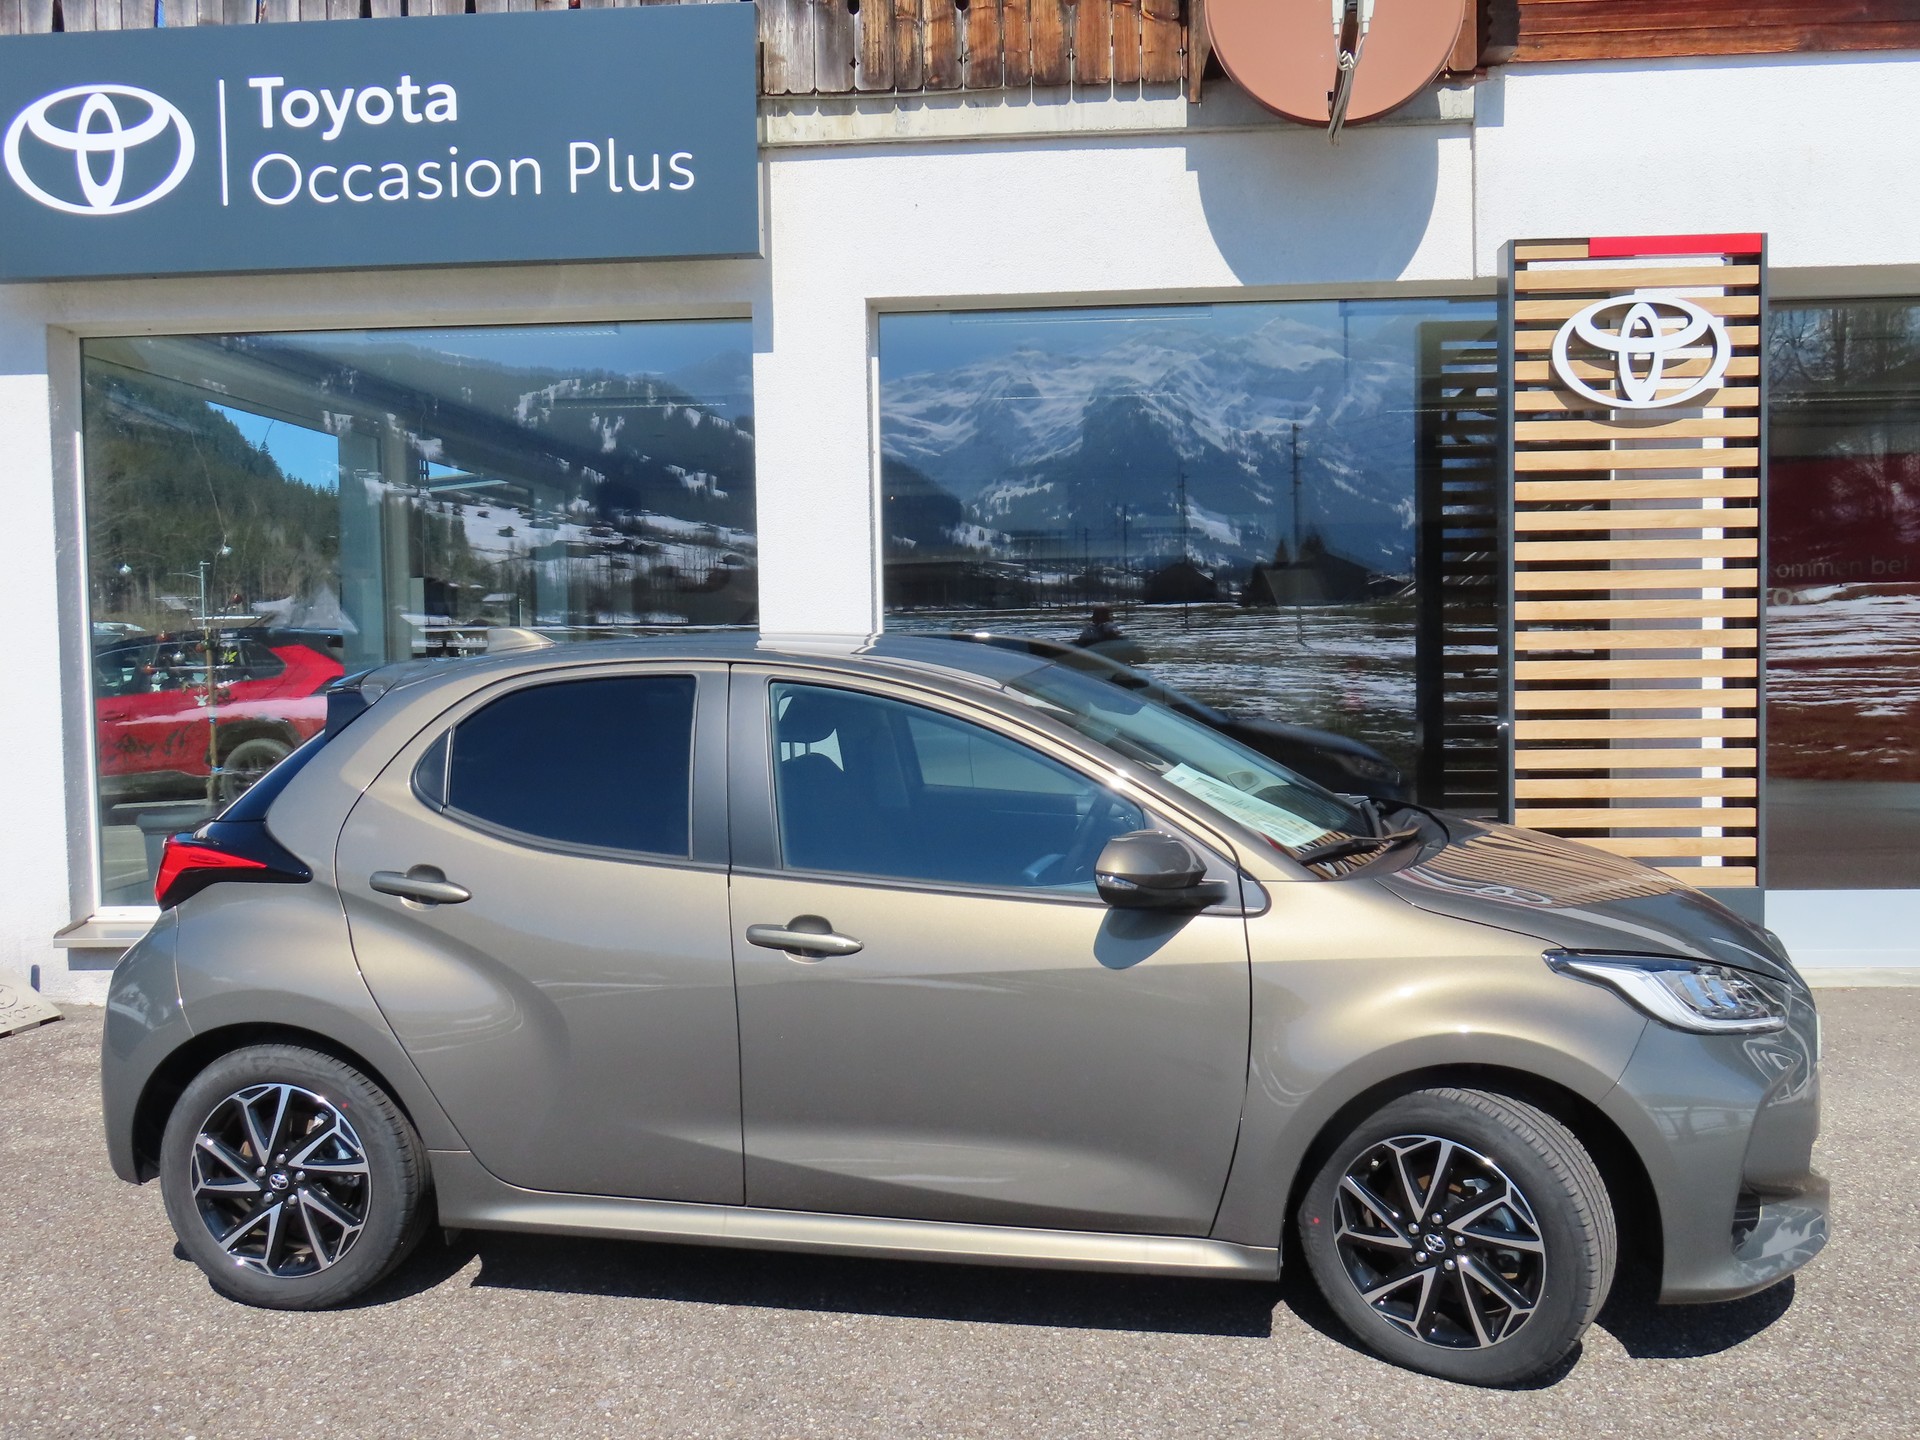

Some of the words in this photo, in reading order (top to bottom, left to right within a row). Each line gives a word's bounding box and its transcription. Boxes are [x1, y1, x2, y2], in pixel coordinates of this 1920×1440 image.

[248, 74, 458, 141] Toyota
[251, 146, 542, 206] Occasion
[569, 137, 695, 194] Plus
